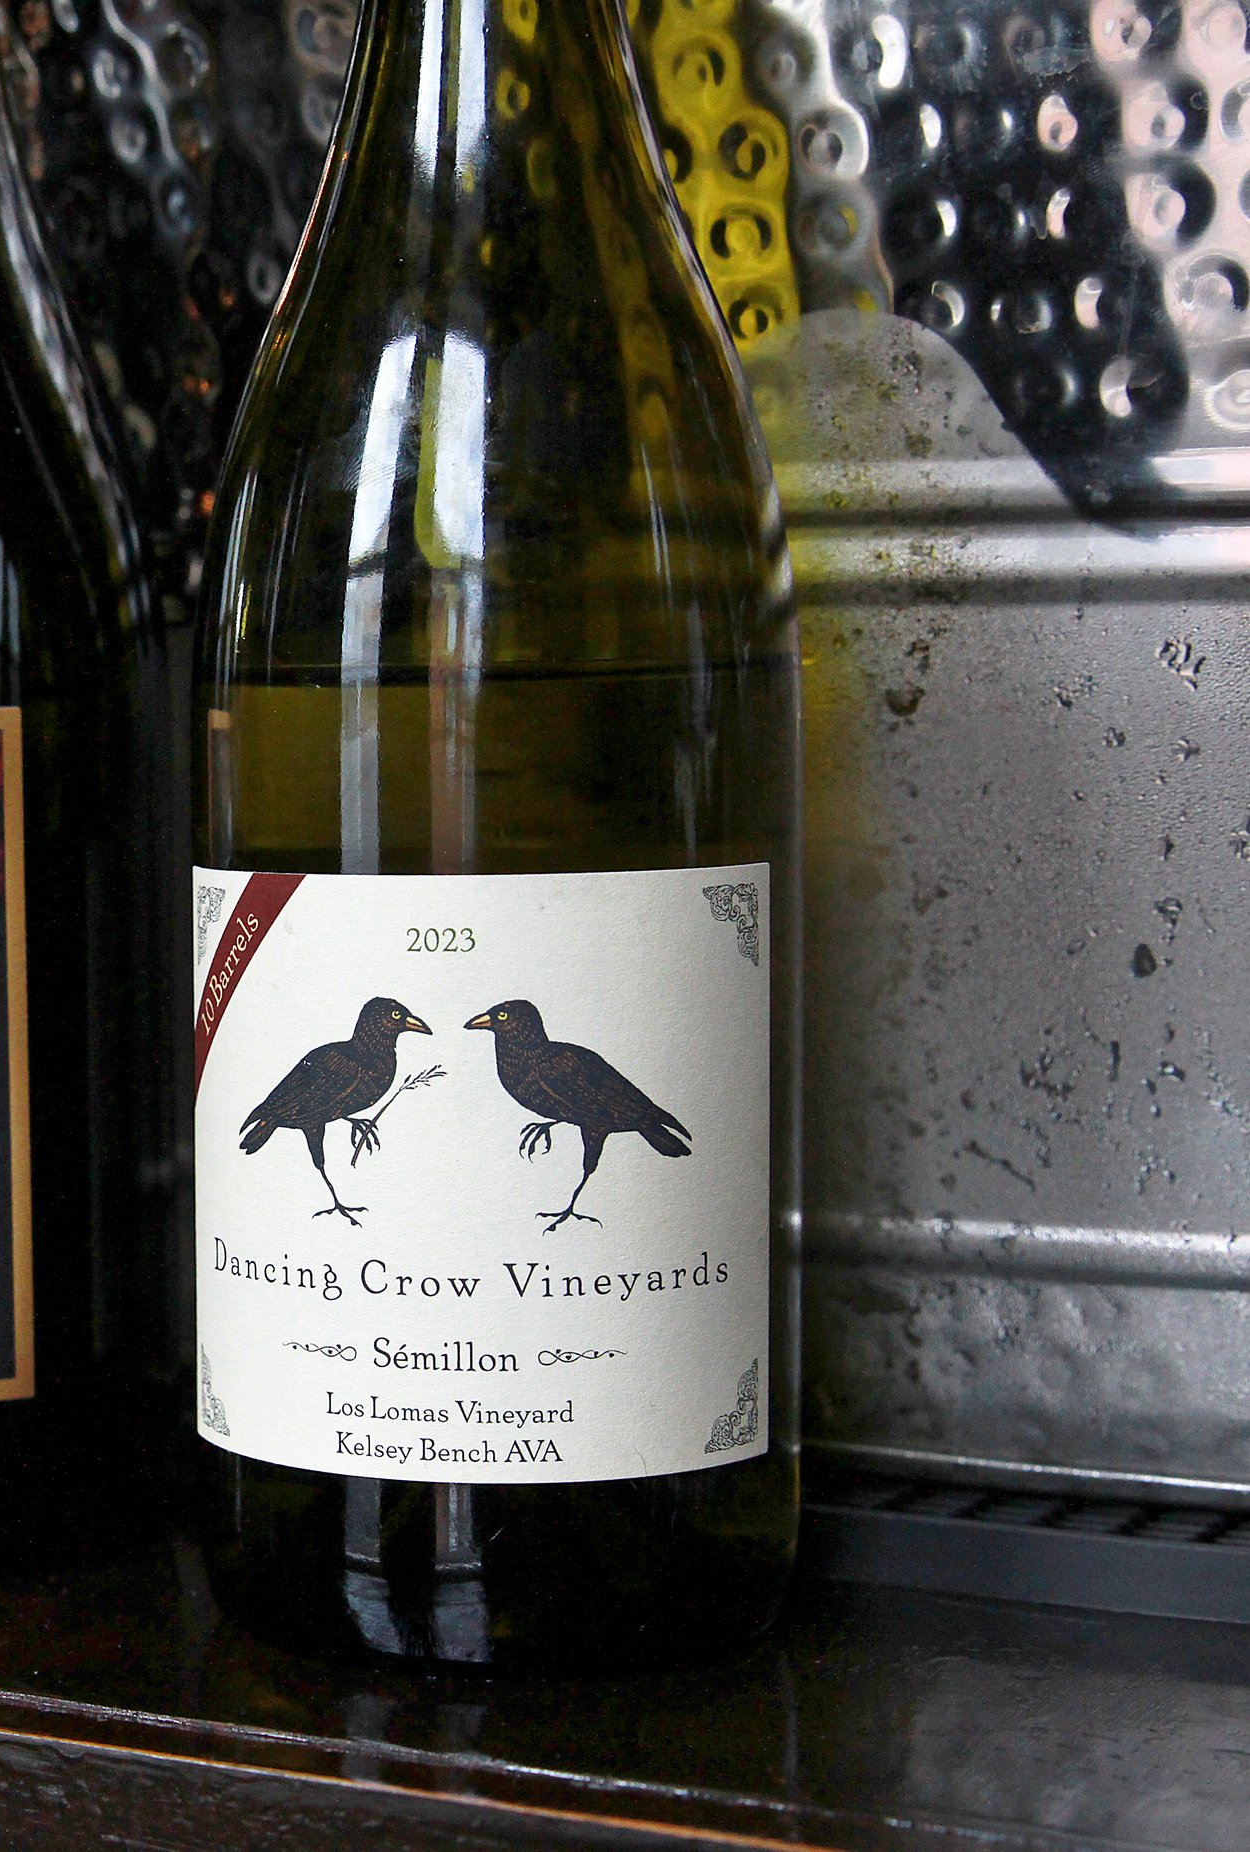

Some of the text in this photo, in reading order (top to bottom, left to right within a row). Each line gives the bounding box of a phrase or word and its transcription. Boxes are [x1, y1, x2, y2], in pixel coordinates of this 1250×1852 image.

[406, 927, 477, 953] 2023
[201, 913, 259, 1036] 10 Barrels
[214, 1236, 729, 1302] Dancing Crow Vineyards
[372, 1336, 520, 1373] Sémillon
[326, 1391, 575, 1428] Los Lomas Vineyard
[336, 1430, 564, 1464] Kelsey Bench AVA
